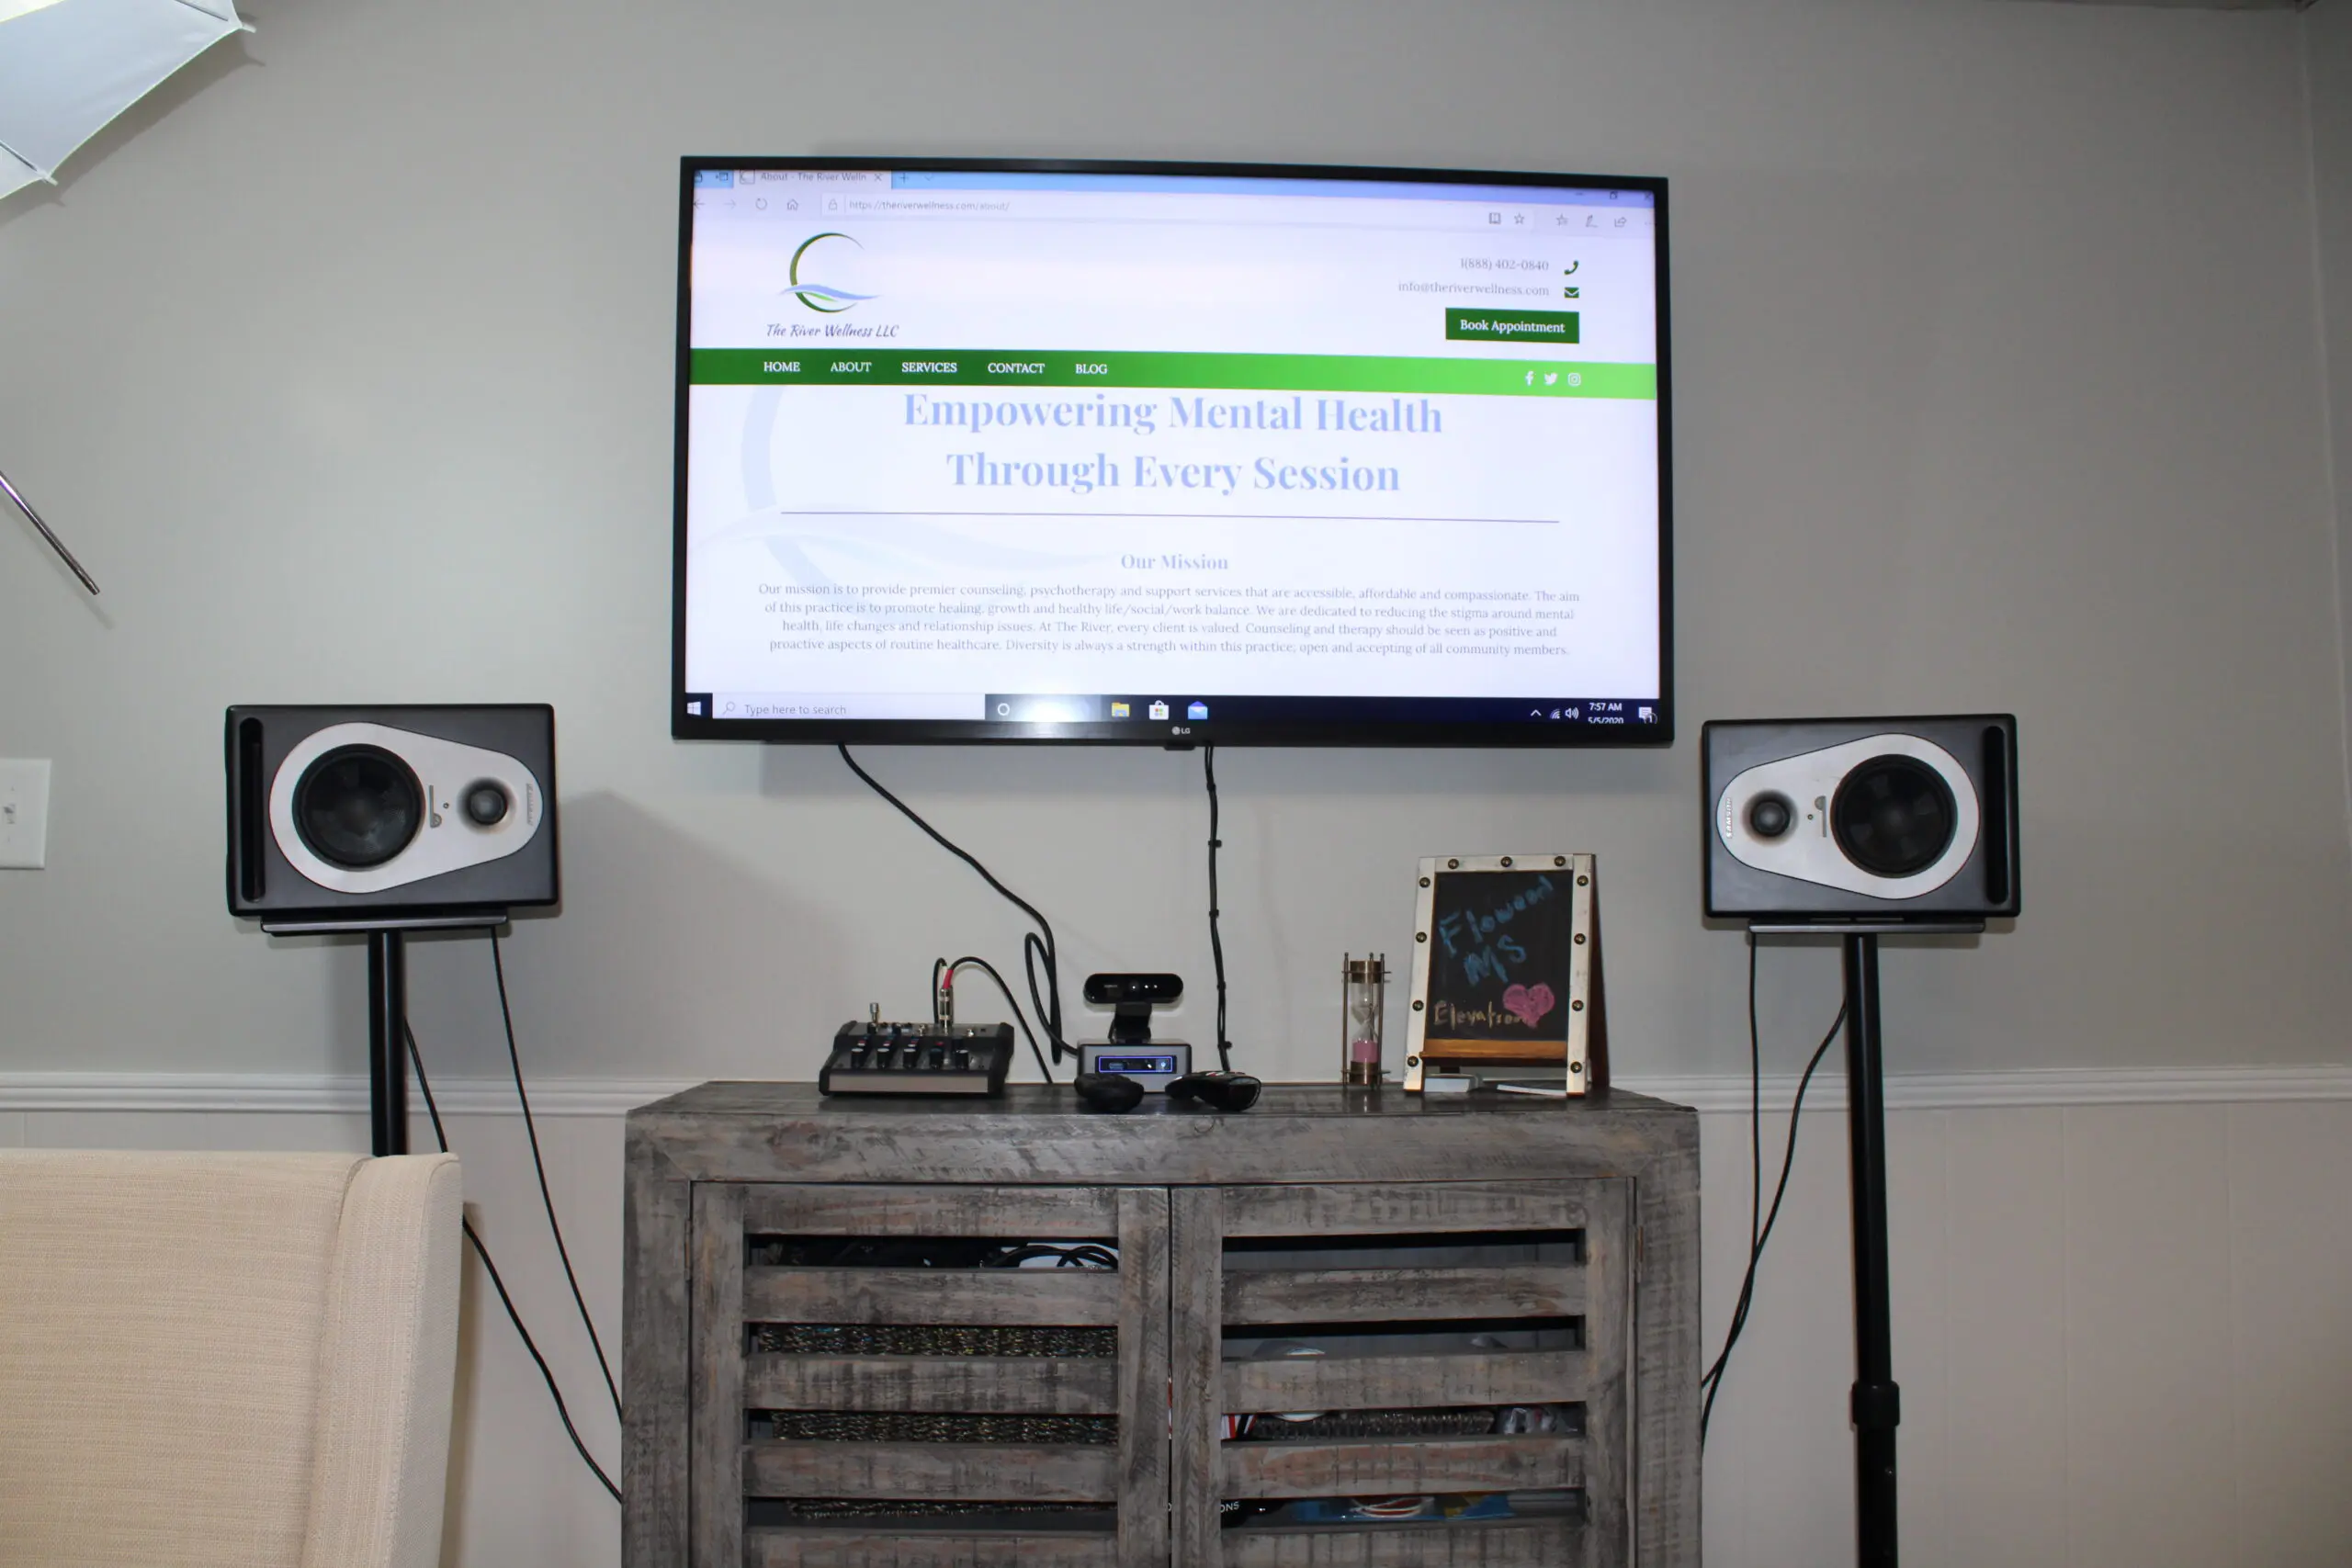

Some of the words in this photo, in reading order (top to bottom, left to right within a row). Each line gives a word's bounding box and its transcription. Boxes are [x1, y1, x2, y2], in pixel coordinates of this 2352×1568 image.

[760, 171, 788, 182] About
[798, 171, 814, 182] The
[817, 171, 839, 182] River
[842, 172, 866, 182] Welln
[1461, 257, 1492, 271] 1(888)
[1496, 259, 1549, 271] 402-0840
[1398, 280, 1550, 296] info@theriverwellness.com
[766, 324, 786, 338] The
[791, 324, 820, 338] River
[825, 324, 873, 338] Wellness
[876, 324, 899, 338] LLC
[1460, 320, 1488, 331] Book
[1491, 321, 1566, 334] Appointment
[763, 361, 800, 372] HOME
[831, 361, 872, 372] ABOUT
[901, 362, 957, 373] SERVICES
[988, 363, 1045, 374] CONTACT
[1075, 364, 1108, 375] BLOG
[904, 394, 1158, 434] Empowering
[1169, 396, 1302, 430] Mental
[1316, 399, 1442, 433] Health
[946, 453, 1119, 494] Through
[1135, 456, 1242, 496] Every
[1253, 457, 1400, 491] Session
[1121, 554, 1156, 570] Our
[1161, 554, 1229, 570] Mission
[758, 581, 782, 594] Our
[785, 581, 831, 594] mission
[832, 582, 845, 595] is
[845, 584, 860, 595] to
[861, 582, 907, 599] provide
[909, 582, 956, 599] premier
[1029, 583, 1116, 600] psychotherapy
[1120, 584, 1143, 597] and
[1145, 586, 1192, 601] support
[1194, 584, 1243, 597] services
[1245, 585, 1269, 598] that
[1271, 589, 1291, 598] are
[1358, 586, 1417, 599] affordable
[1419, 587, 1442, 600] and
[1534, 589, 1557, 602] The
[1558, 589, 1580, 602] aim
[763, 600, 777, 613] of
[779, 600, 803, 613] this
[804, 600, 854, 616] practice
[855, 601, 867, 614] is
[868, 603, 883, 614] to
[884, 603, 936, 617] promote
[987, 602, 1031, 618] growth
[1033, 602, 1056, 615] and
[1057, 602, 1102, 618] healthy
[1104, 603, 1203, 617] life/social/work
[1255, 604, 1275, 616] We
[1277, 607, 1297, 616] are
[1299, 604, 1357, 617] dedicated
[1359, 606, 1373, 617] to
[1374, 605, 1427, 622] reducing
[1429, 605, 1448, 618] the
[1450, 606, 1489, 623] stigma
[1491, 606, 1532, 619] around
[1534, 607, 1575, 620] mental
[825, 618, 844, 631] life
[846, 619, 898, 636] changes
[898, 619, 922, 632] and
[922, 619, 995, 636] relationship
[1038, 620, 1052, 633] At
[1057, 620, 1078, 633] The
[1116, 625, 1150, 637] every
[1151, 621, 1185, 634] client
[1188, 621, 1199, 634] is
[1245, 622, 1312, 638] Counseling
[1313, 622, 1336, 635] and
[1338, 623, 1384, 639] therapy
[1385, 623, 1425, 636] should
[1426, 624, 1442, 637] be
[1443, 627, 1471, 637] seen
[1473, 627, 1487, 637] as
[1487, 625, 1533, 641] positive
[1535, 625, 1557, 637] and
[769, 637, 825, 653] proactive
[827, 639, 873, 654] aspects
[874, 637, 888, 650] of
[889, 637, 934, 650] routine
[1005, 638, 1059, 655] Diversity
[1061, 638, 1073, 651] is
[1074, 638, 1114, 655] always
[1115, 643, 1125, 652] a
[1125, 639, 1177, 656] strength
[1179, 639, 1217, 652] within
[1219, 640, 1243, 653] this
[1298, 644, 1329, 657] open
[1330, 641, 1353, 654] and
[1355, 641, 1413, 658] accepting
[1414, 642, 1428, 655] of
[1429, 642, 1443, 655] all
[1445, 642, 1510, 659] community
[744, 704, 769, 717] Type
[772, 704, 796, 715] here
[799, 705, 809, 715] to
[813, 704, 847, 716] search
[1589, 703, 1606, 711] 7:57
[1608, 703, 1622, 711] AM
[1464, 934, 1527, 986] MS
